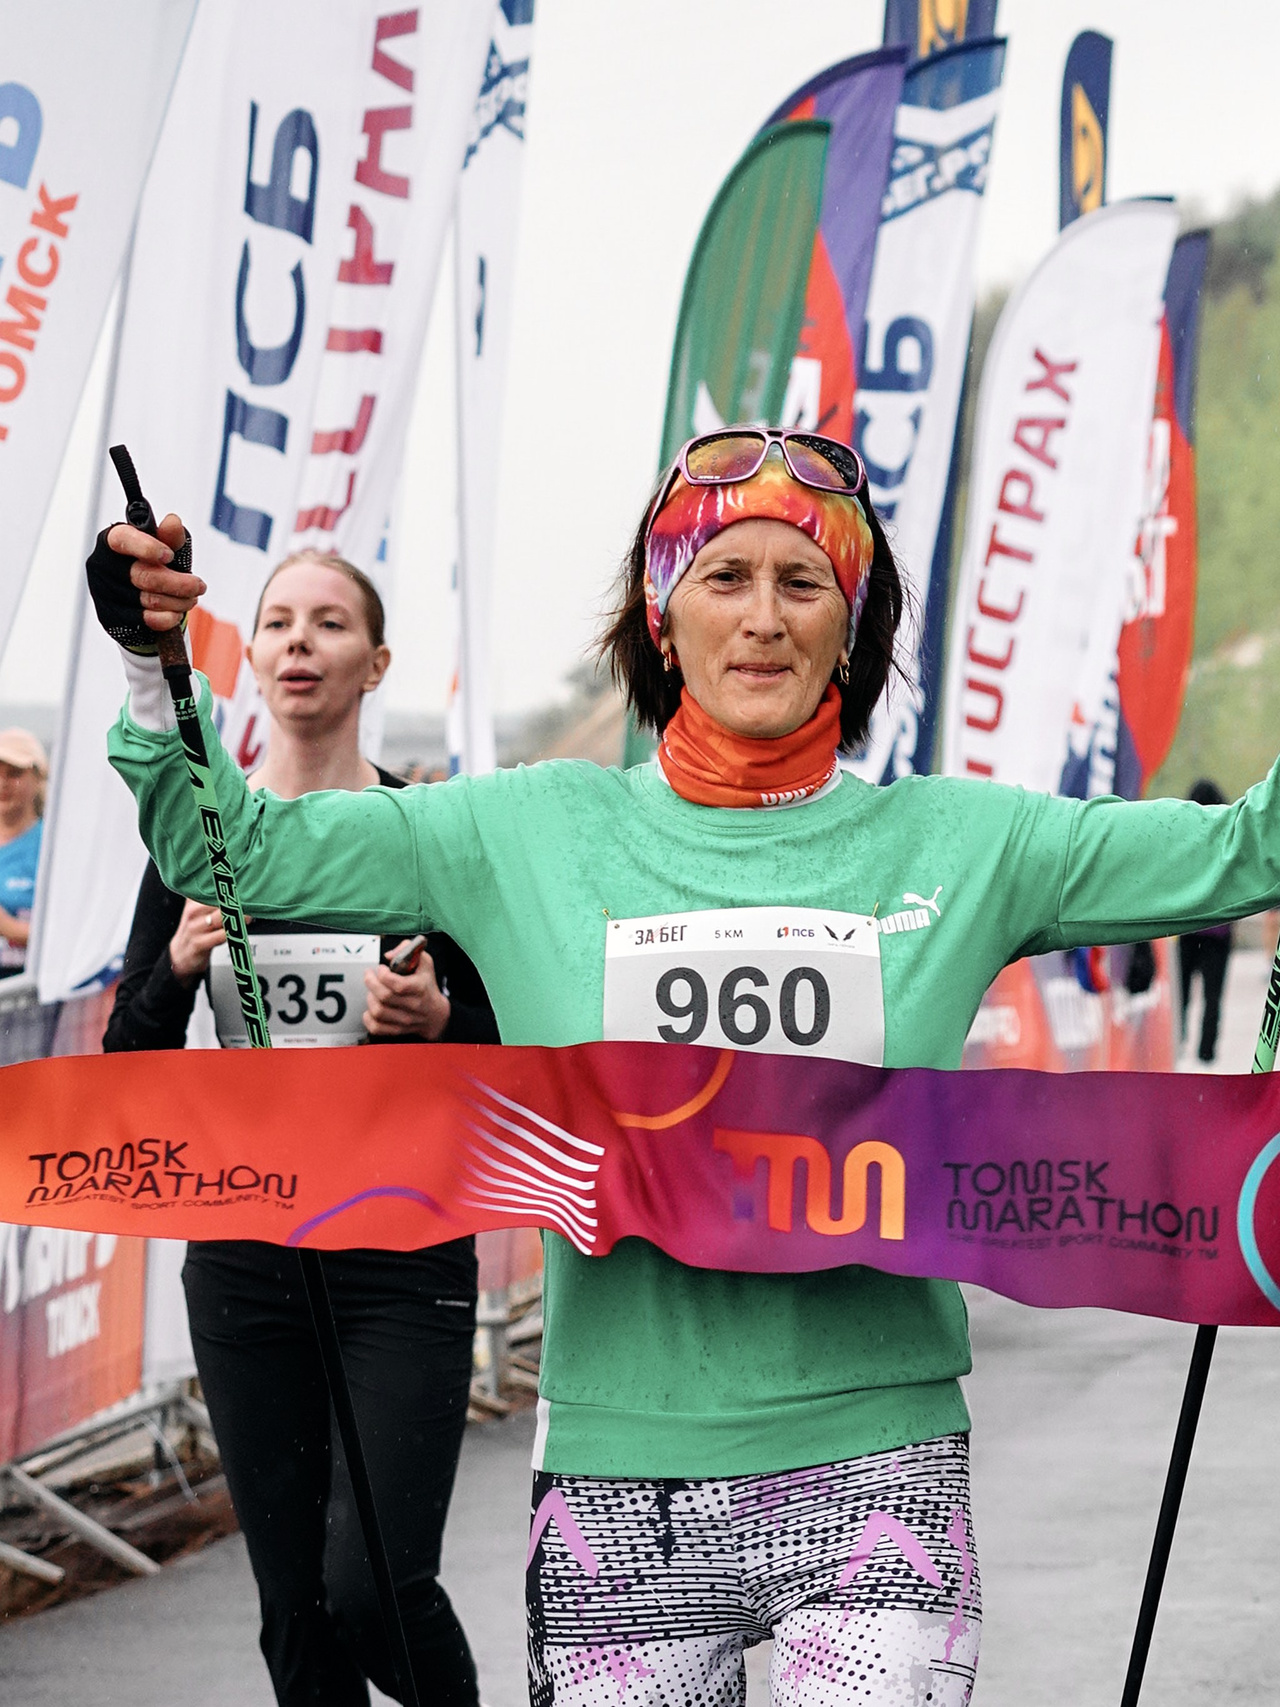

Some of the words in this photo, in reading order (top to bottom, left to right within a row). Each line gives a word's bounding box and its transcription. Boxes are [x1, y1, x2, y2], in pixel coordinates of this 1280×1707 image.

[0, 179, 80, 443] ОМСК
[210, 100, 320, 553] ПСБ
[856, 316, 934, 520] СБ
[792, 928, 815, 938] ПСБ
[876, 907, 931, 935] UMA
[655, 966, 831, 1046] 960
[26, 1165, 298, 1203] MARATHON
[28, 1138, 188, 1185] TOMSK
[942, 1159, 1109, 1197] TOMSK
[947, 1194, 1219, 1243] MARATHON
